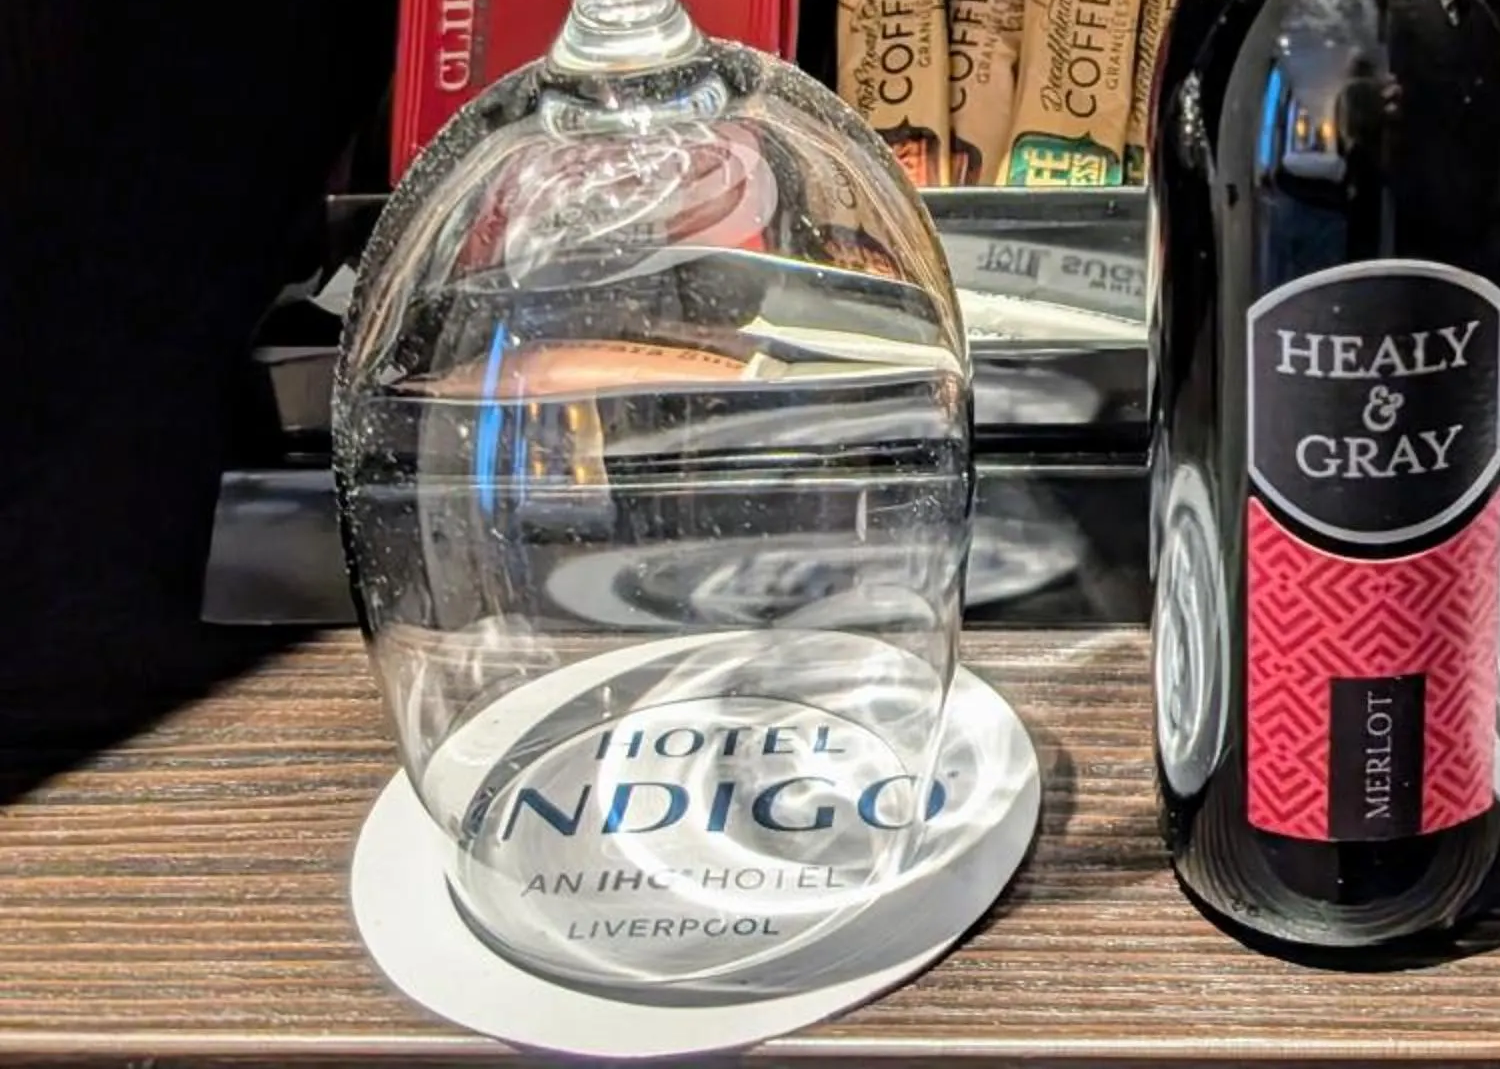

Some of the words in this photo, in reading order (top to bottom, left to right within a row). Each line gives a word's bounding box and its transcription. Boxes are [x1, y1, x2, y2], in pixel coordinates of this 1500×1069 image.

[1275, 320, 1482, 379] HEALY
[1361, 385, 1404, 432] &
[1295, 424, 1463, 480] GRAY
[594, 725, 846, 761] HOTEL
[1365, 690, 1395, 821] MERLOT
[501, 774, 947, 842] NDIGO
[520, 871, 584, 898] AN
[566, 916, 781, 941] LIVERPOOL
